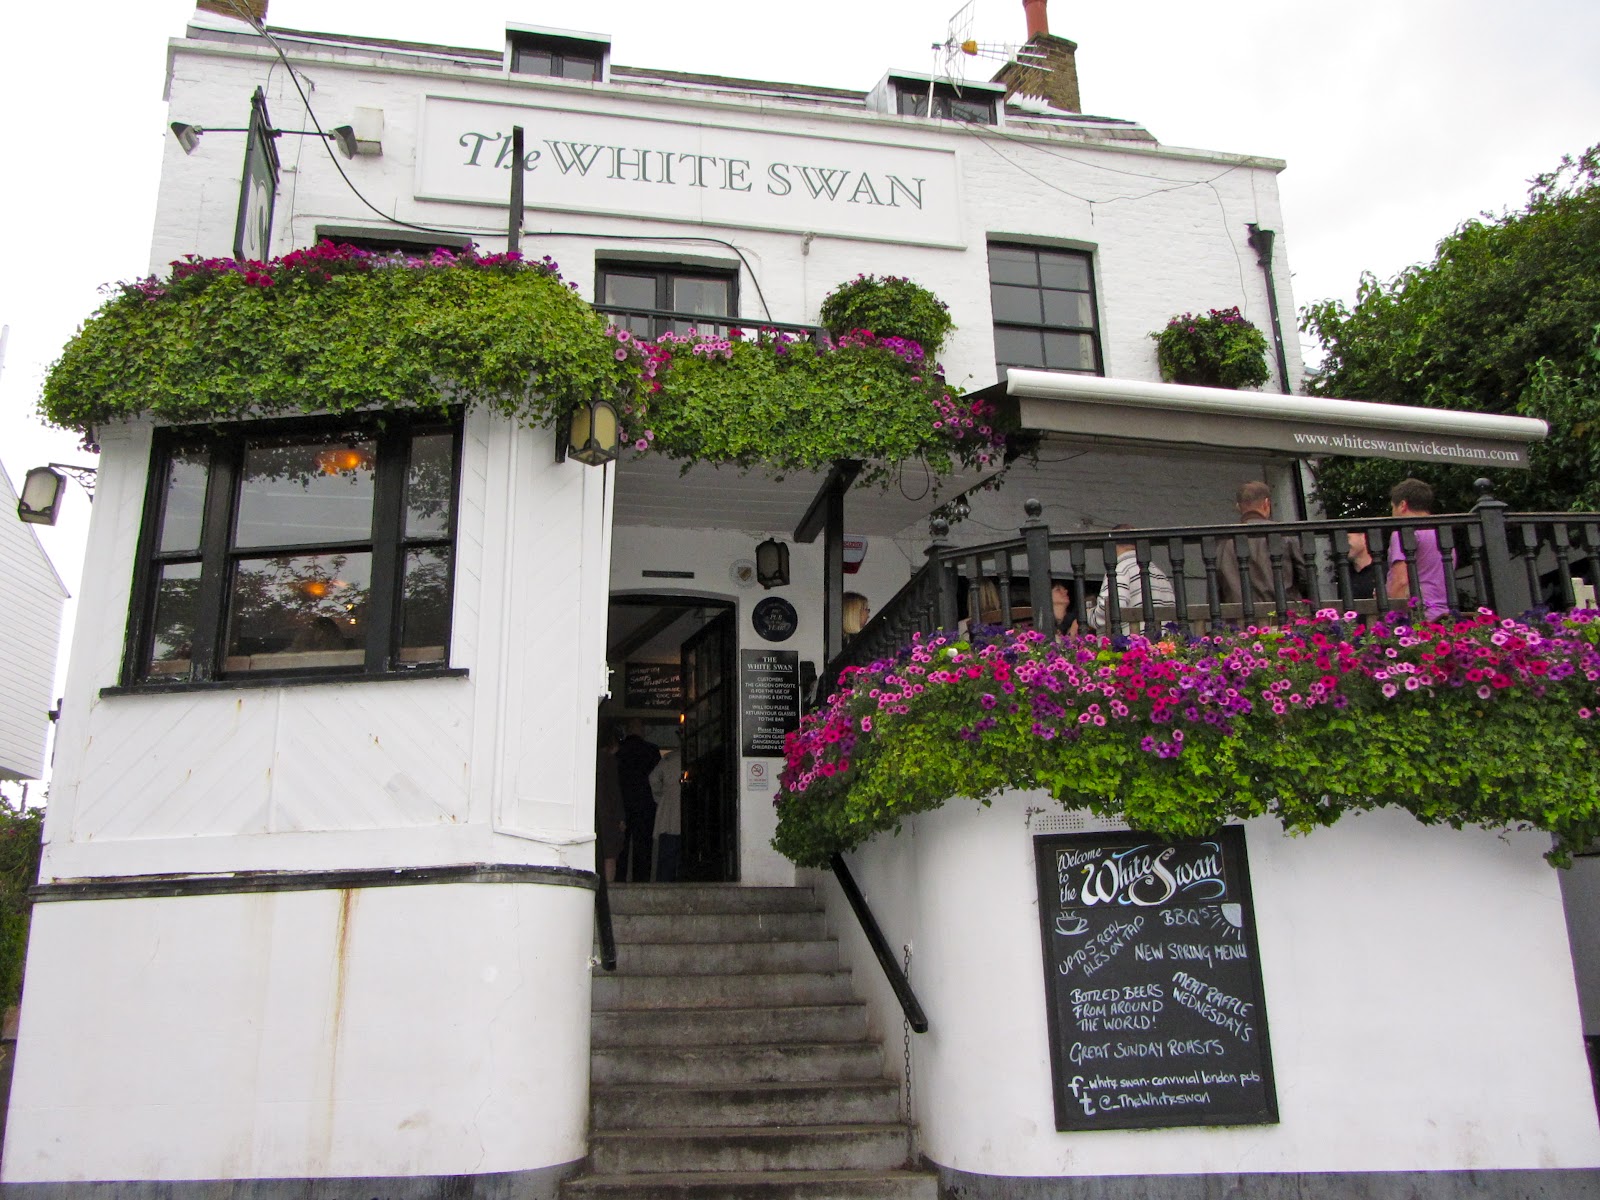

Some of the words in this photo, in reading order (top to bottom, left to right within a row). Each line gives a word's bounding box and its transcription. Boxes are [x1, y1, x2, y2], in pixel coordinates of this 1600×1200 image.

[458, 132, 541, 172] The
[542, 139, 753, 194] WHITE
[766, 162, 926, 211] SWAN
[1293, 432, 1520, 461] www.whiteswantwickenham.com
[1058, 848, 1103, 873] Welcome
[1059, 871, 1070, 885] to
[1081, 854, 1154, 906] White
[1128, 847, 1224, 907] Swan
[1060, 882, 1078, 903] the
[1083, 950, 1111, 978] ALES
[1110, 936, 1125, 956] ON
[1122, 915, 1145, 941] TAP
[1084, 938, 1097, 956] 5
[1096, 920, 1129, 947] REAL
[1134, 942, 1164, 961] NEW
[1169, 942, 1213, 969] SPRING
[1214, 943, 1248, 961] MENU
[1122, 983, 1164, 1000] BEERS
[1171, 971, 1209, 995] MEAT
[1205, 986, 1254, 1018] RAFFLE
[1072, 1002, 1107, 1019] FROM
[1110, 999, 1164, 1015] AROUND
[1076, 1017, 1100, 1032] THE
[1103, 1014, 1157, 1031] WORLD!
[1172, 986, 1253, 1042] WEDNESDAY'S
[1069, 1041, 1111, 1067] GREAT
[1113, 1042, 1163, 1059] SUNDAY
[1167, 1038, 1225, 1056] ROASTS
[1151, 1069, 1200, 1086] convivial
[1201, 1070, 1237, 1085] london
